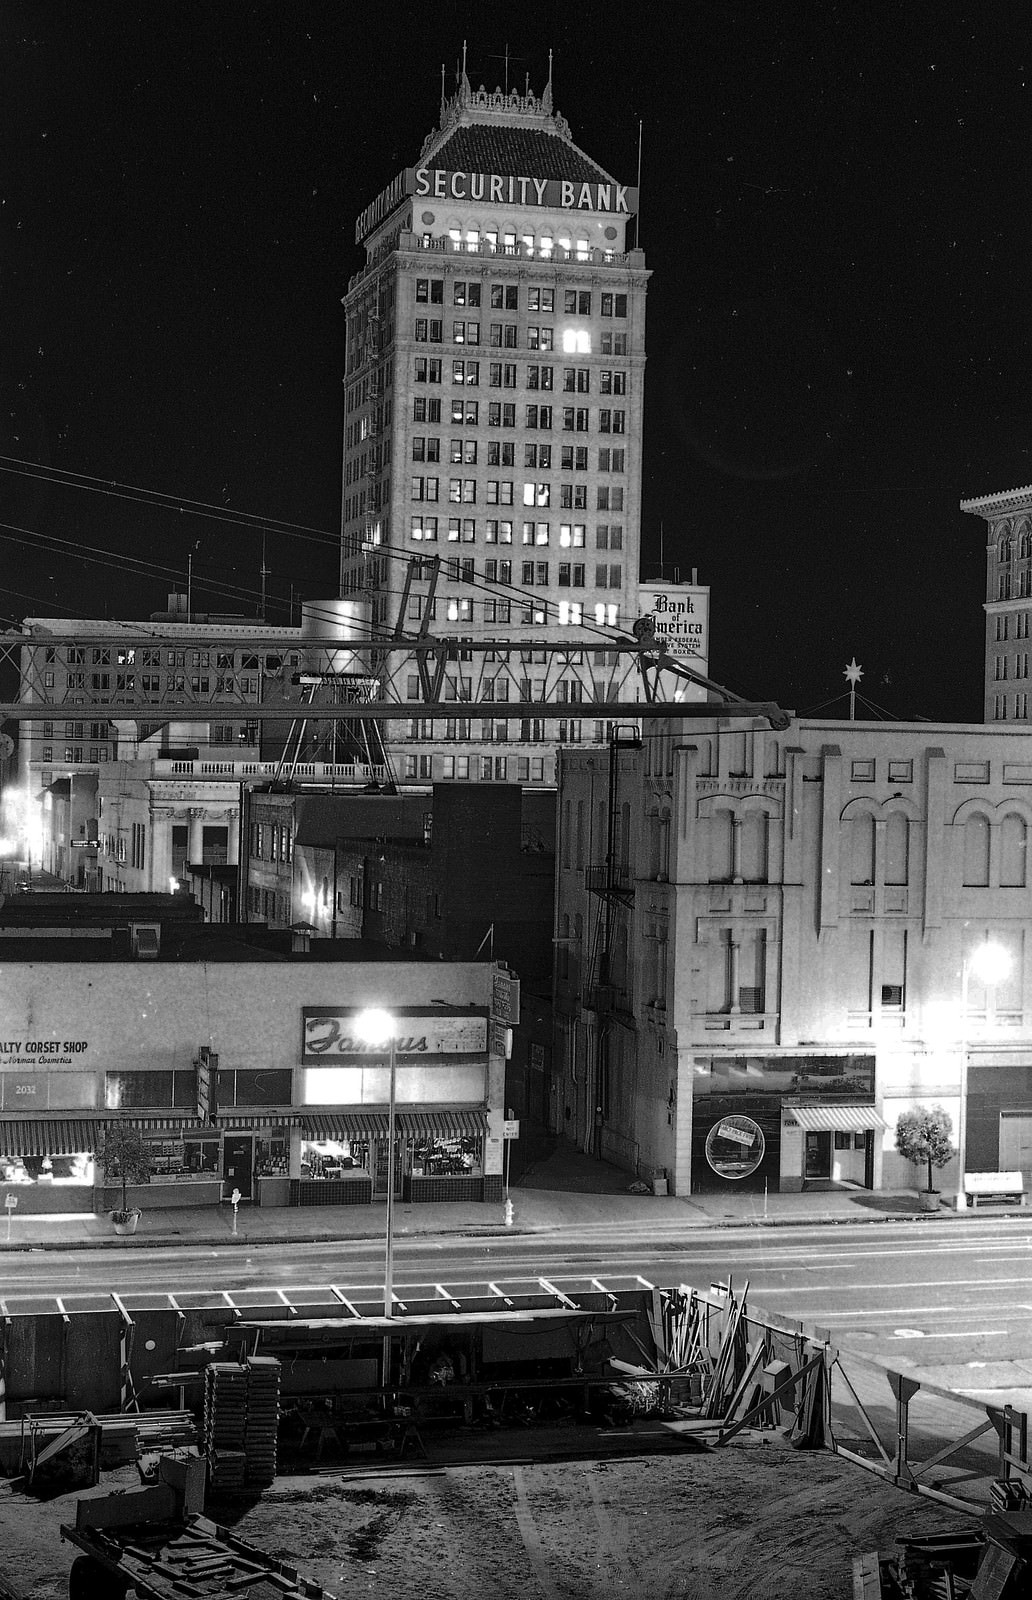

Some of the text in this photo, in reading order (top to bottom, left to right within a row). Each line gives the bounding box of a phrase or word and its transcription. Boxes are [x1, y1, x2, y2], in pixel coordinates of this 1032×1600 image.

[416, 169, 629, 213] SECURITY BANK
[651, 594, 694, 613] Bank
[672, 613, 681, 621] of
[25, 1041, 61, 1053] CORSET
[63, 1041, 88, 1053] SHOP
[38, 1055, 72, 1064] Cosmetics
